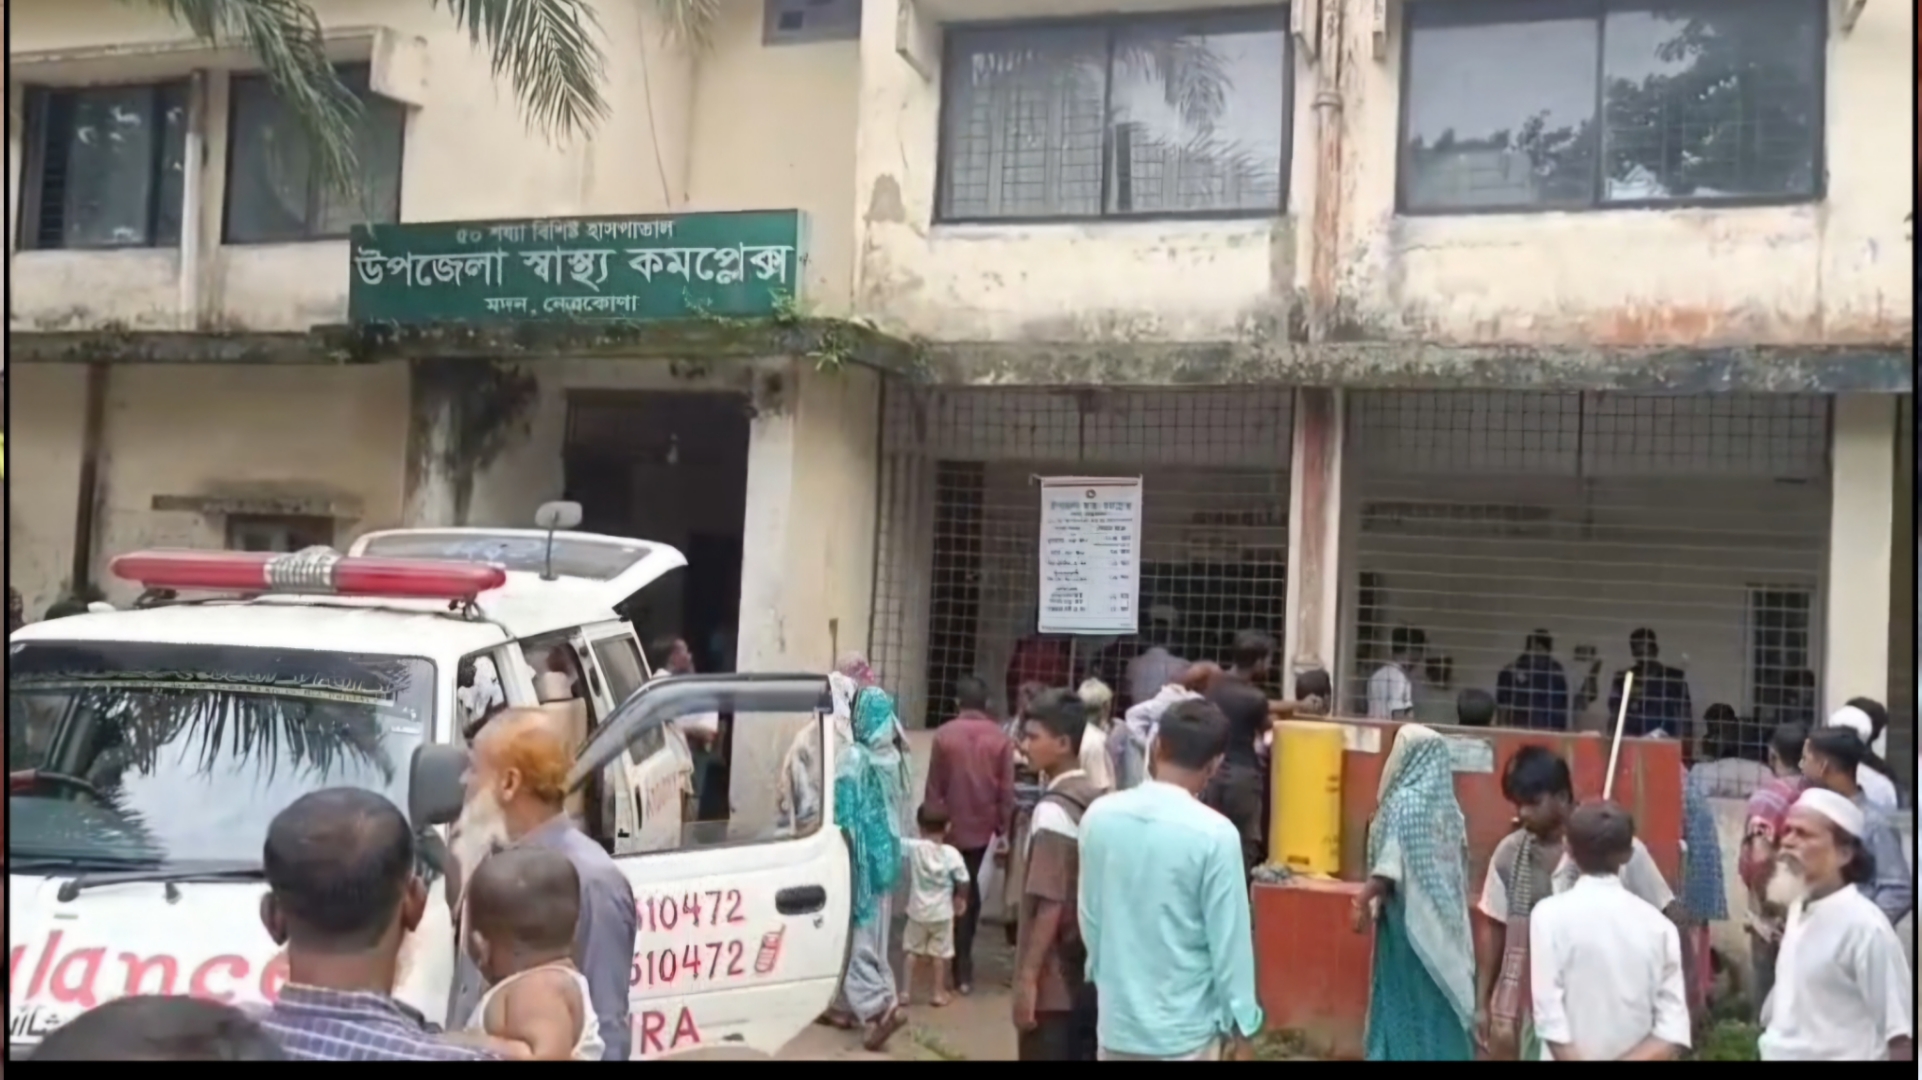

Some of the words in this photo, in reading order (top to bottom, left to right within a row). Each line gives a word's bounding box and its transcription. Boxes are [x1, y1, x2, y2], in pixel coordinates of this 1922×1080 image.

[354, 246, 509, 287] উপজেলা
[518, 245, 617, 292] স্বাস্থ্য
[625, 241, 795, 285] কমপ্লেক্স
[628, 1005, 701, 1055] RA
